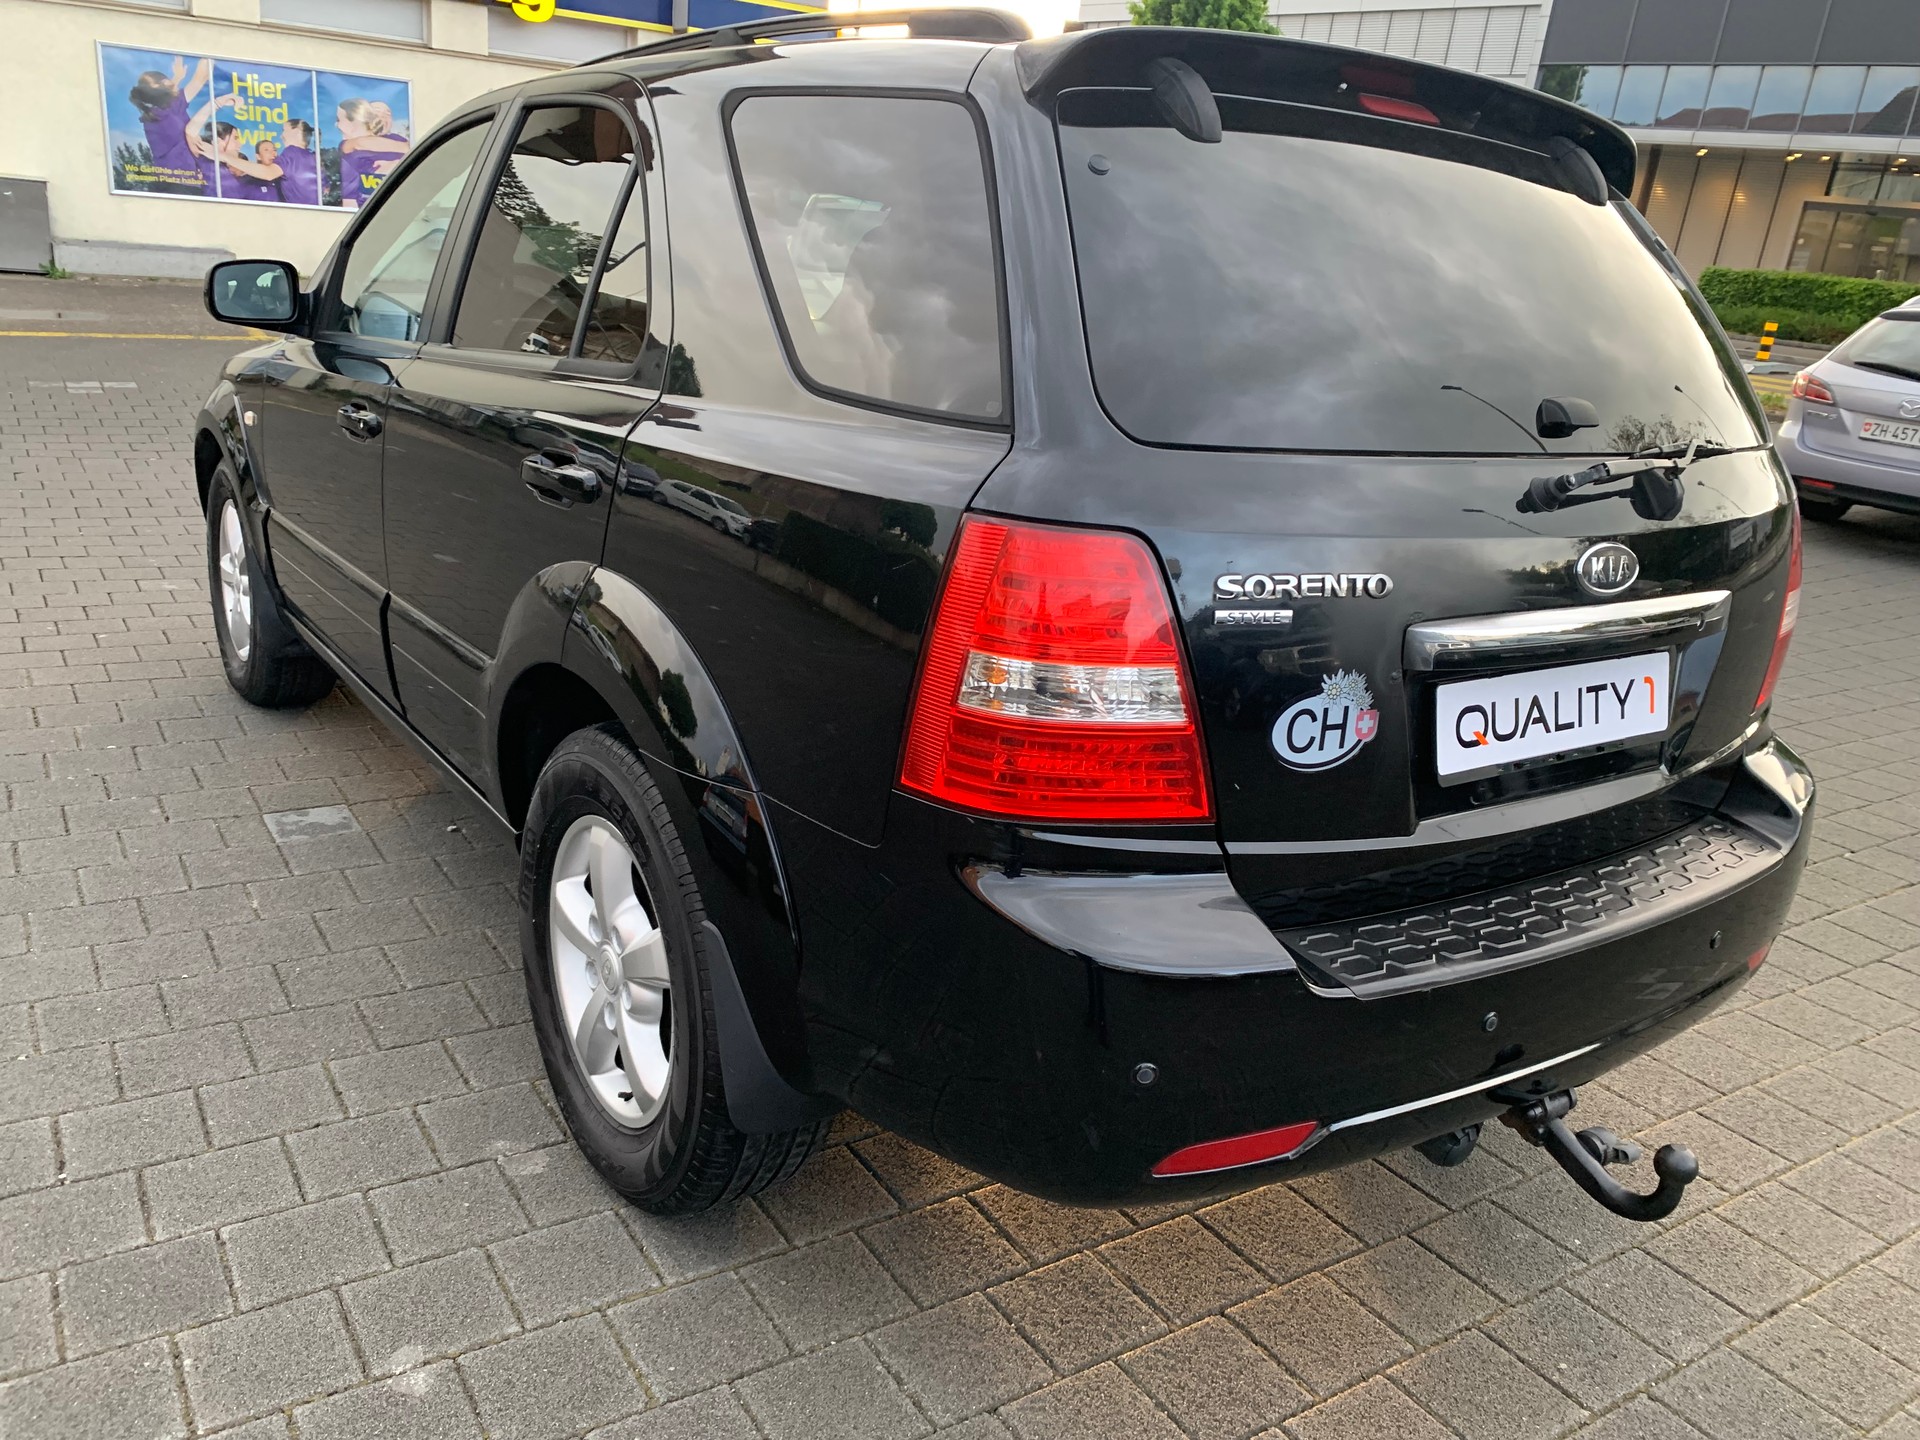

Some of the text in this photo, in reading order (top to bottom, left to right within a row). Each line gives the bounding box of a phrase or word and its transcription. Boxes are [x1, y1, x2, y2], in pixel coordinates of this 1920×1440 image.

[232, 72, 287, 100] Hier
[234, 98, 288, 124] sind
[140, 165, 172, 175] Gefühle
[173, 168, 196, 176] einen
[160, 175, 180, 183] Platz
[1591, 555, 1630, 583] KIA
[1214, 573, 1394, 600] SORENTO
[1226, 611, 1281, 624] STYLE
[1456, 676, 1654, 748] QUALITY 1
[1286, 705, 1350, 754] CH
